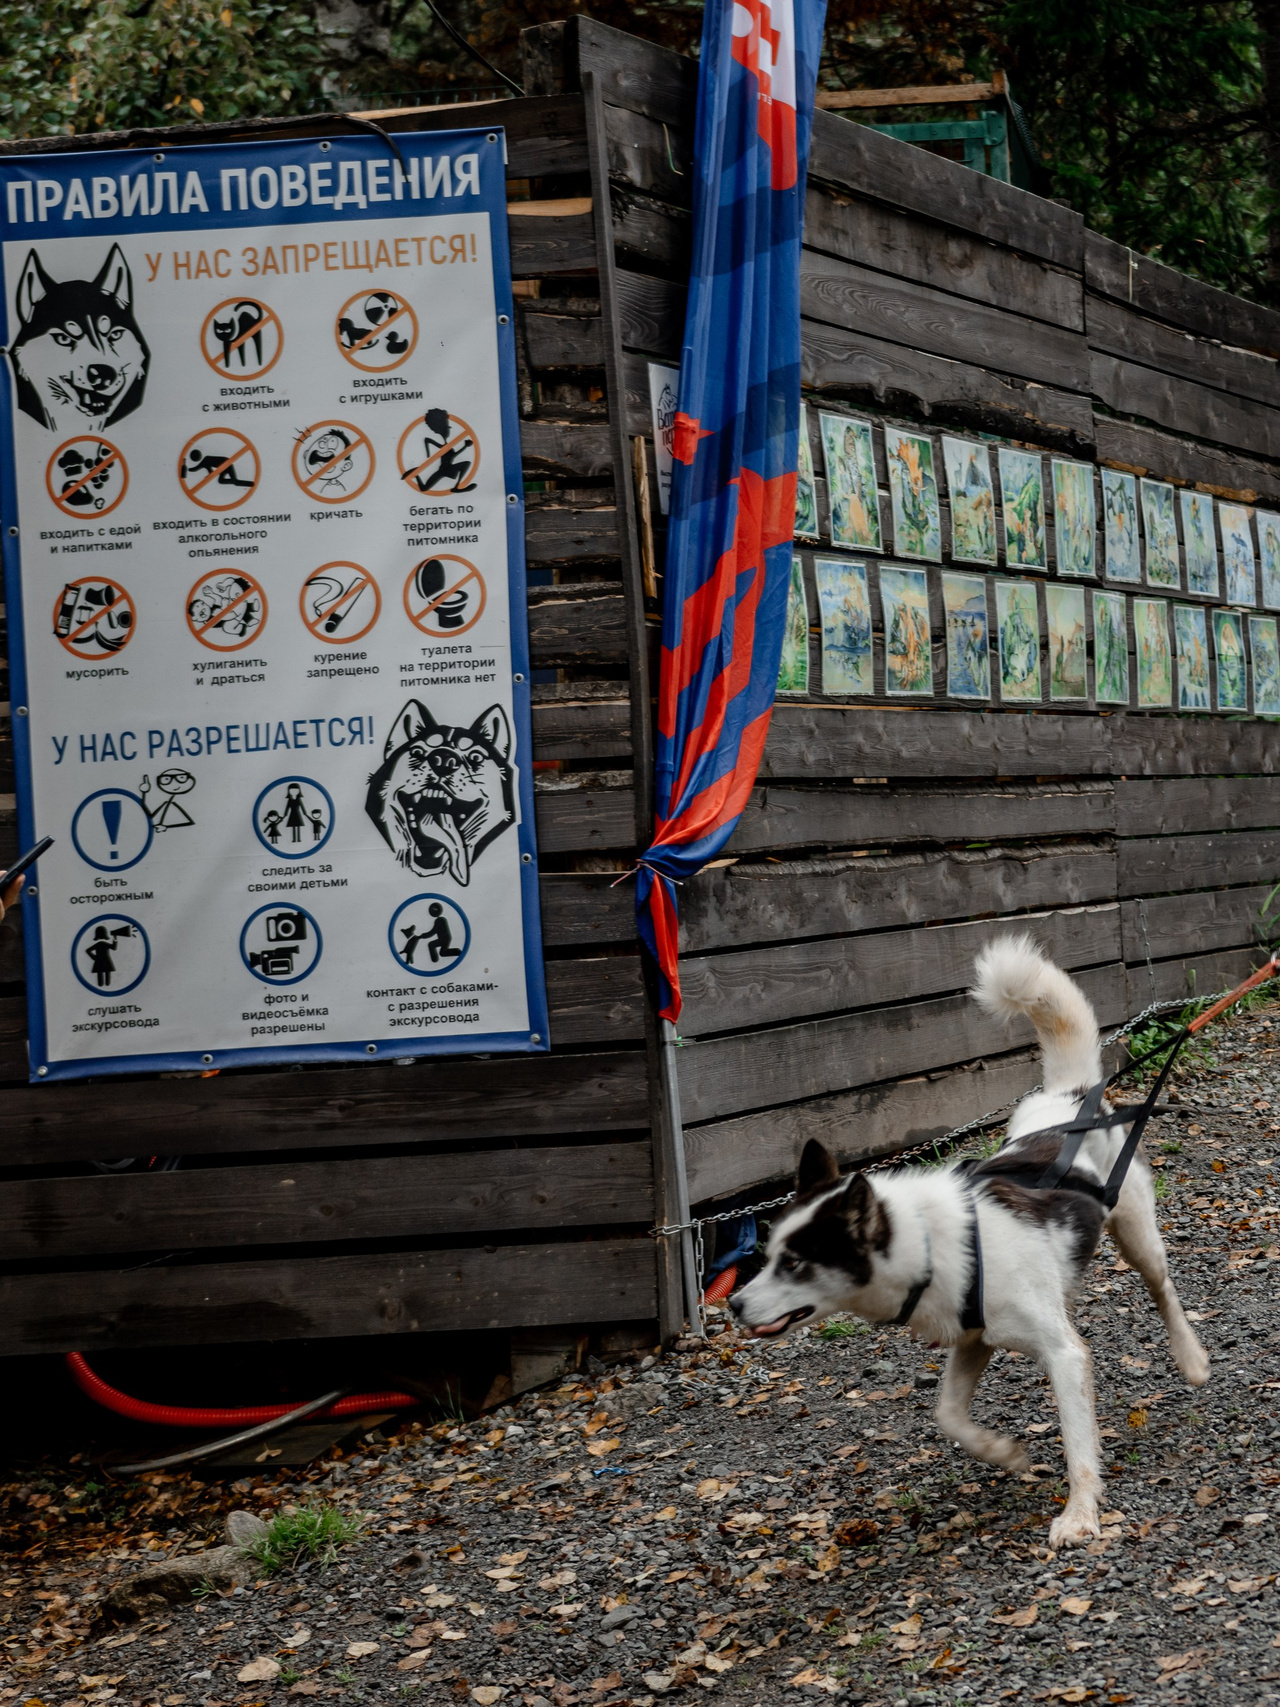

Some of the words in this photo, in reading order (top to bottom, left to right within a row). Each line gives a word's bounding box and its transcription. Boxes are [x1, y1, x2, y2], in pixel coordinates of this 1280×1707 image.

[7, 171, 209, 223] ПРАВИЛА
[220, 153, 480, 211] ПОВЕДЕНИЯ
[145, 252, 163, 281] У
[174, 248, 232, 280] НАС
[241, 233, 478, 277] ЗАПРЕЩАЕТСЯ!
[352, 377, 408, 388] входить
[219, 385, 275, 397] входить
[338, 395, 347, 404] с
[350, 391, 423, 405] игрушками
[201, 403, 210, 413] с
[212, 399, 291, 412] животными
[309, 509, 363, 523] кричать
[409, 505, 454, 517] бегать
[457, 504, 474, 514] по
[152, 519, 208, 531] входить
[211, 518, 220, 527] в
[222, 513, 292, 526] состоянии
[402, 519, 482, 534] территории
[39, 529, 95, 540] входить
[97, 527, 106, 537] с
[108, 523, 142, 537] едой
[178, 530, 268, 544] алкогольного
[50, 545, 59, 554] и
[61, 541, 133, 553] напитками
[407, 534, 479, 547] питомника
[188, 545, 259, 558] опьянения
[314, 651, 368, 665] курение
[420, 644, 473, 659] туалета
[192, 658, 268, 674] хулиганить
[306, 665, 380, 680] запрещено
[399, 663, 415, 673] на
[417, 658, 496, 673] территории
[65, 667, 130, 682] мусорить
[195, 677, 204, 686] и
[210, 673, 266, 687] драться
[400, 675, 471, 688] питомника
[474, 673, 497, 683] нет
[51, 735, 69, 765] У
[79, 731, 138, 763] НАС
[149, 716, 375, 759] РАЗРЕШАЕТСЯ!
[261, 865, 316, 877] следить
[318, 864, 333, 873] за
[94, 876, 128, 889] быть
[247, 881, 297, 893] своими
[299, 878, 348, 891] детьми
[69, 891, 154, 906] осторожным
[366, 987, 417, 999] контакт
[419, 986, 428, 995] с
[430, 982, 499, 995] собаками-
[263, 993, 298, 1007] фото
[301, 993, 310, 1002] и
[387, 1003, 396, 1012] с
[398, 998, 480, 1014] разрешения
[87, 1004, 142, 1018] слушать
[241, 1007, 329, 1021] видеосъёмка
[71, 1017, 160, 1034] экскурсовода
[388, 1013, 480, 1028] экскурсовода
[250, 1022, 326, 1038] разрешены
